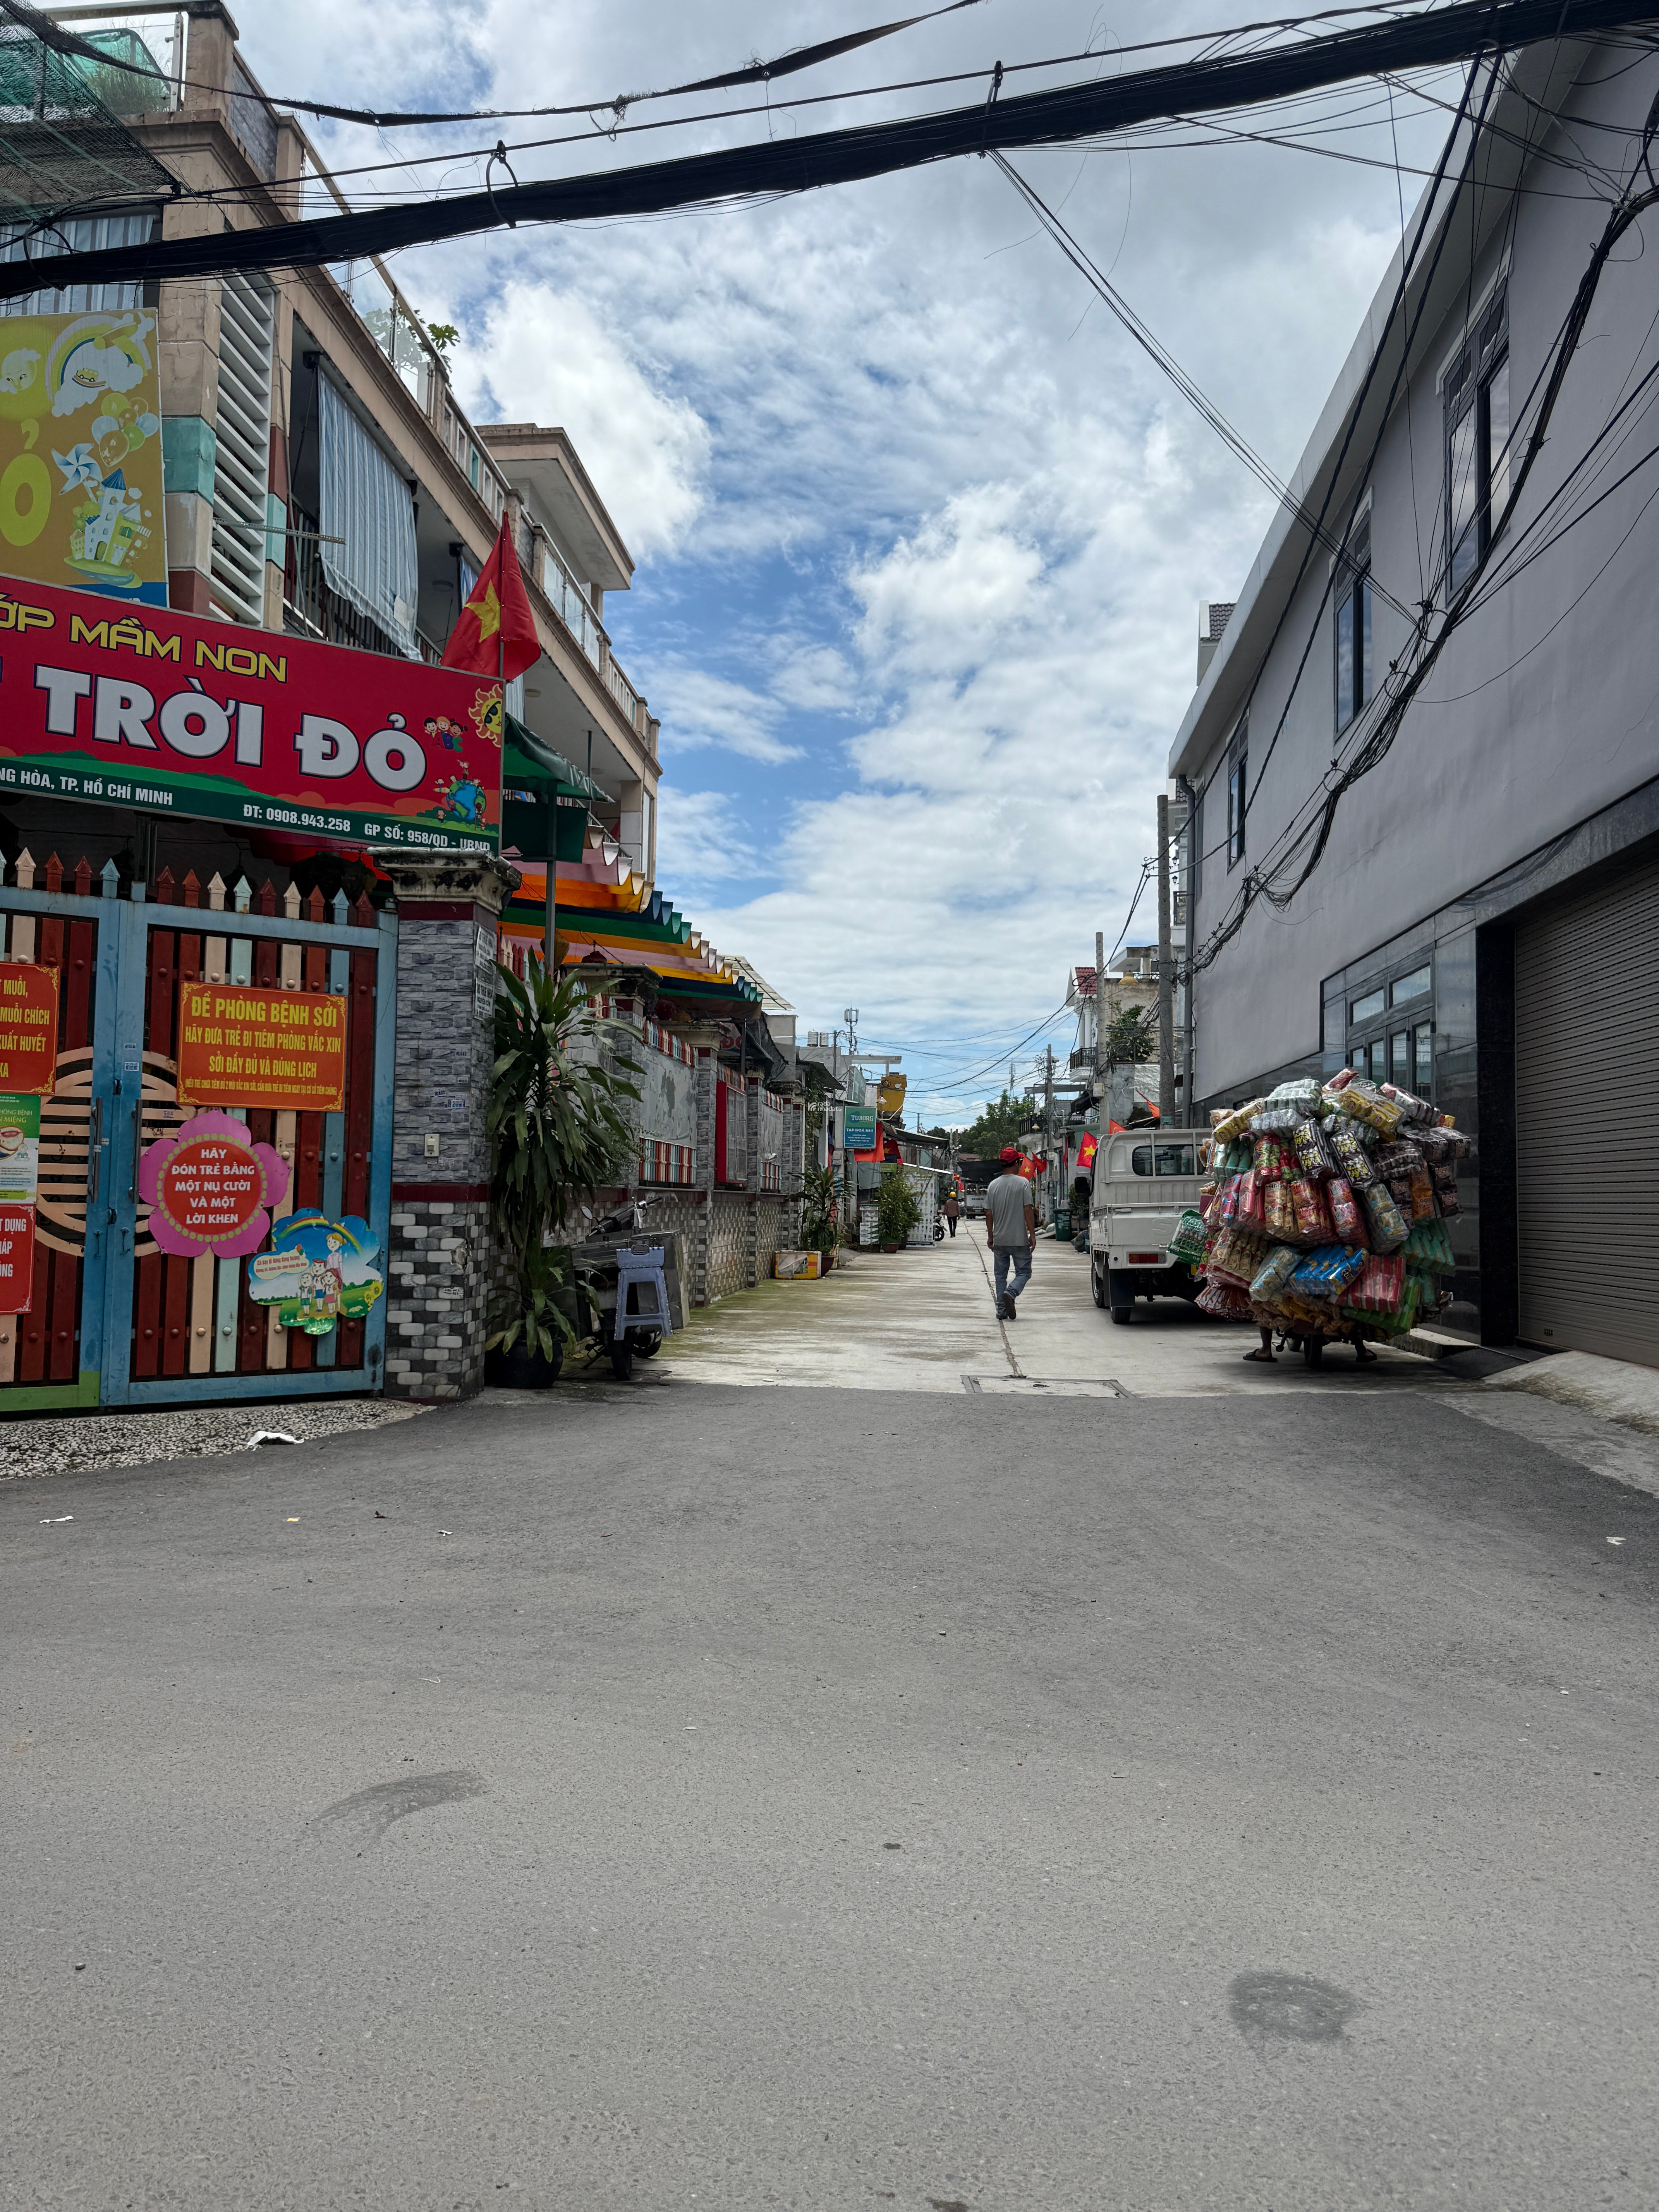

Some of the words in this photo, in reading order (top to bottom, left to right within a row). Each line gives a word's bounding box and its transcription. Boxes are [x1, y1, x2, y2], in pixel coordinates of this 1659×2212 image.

[70, 614, 181, 662] MẦM
[195, 638, 287, 684] NON
[34, 663, 264, 768] TRỜI
[293, 712, 427, 793] ĐỎ
[21, 769, 55, 790] HÒA,
[60, 776, 79, 792] TP.
[84, 778, 103, 795] HỒ
[108, 784, 131, 799] CHÍ
[136, 788, 173, 805] MINH
[243, 804, 262, 818] ĐT:
[266, 808, 350, 832] 0908.943.258
[364, 823, 380, 836] GP
[384, 824, 404, 840] SỐ:
[407, 830, 448, 847] 958/QD
[3, 975, 28, 998] MUỖI,
[0, 1003, 22, 1023] MUỖI
[24, 1006, 50, 1025] CHÍCH
[191, 991, 211, 1017] ĐỀ
[215, 995, 266, 1021] PHÒNG
[271, 1000, 309, 1028] BỆNH
[313, 1001, 337, 1027] SỞI
[20, 1032, 46, 1052] HUYẾT
[185, 1024, 203, 1043] HÃY
[204, 1027, 222, 1045] ĐƯA
[225, 1025, 240, 1046] TRẺ
[243, 1030, 252, 1047] ĐI
[254, 1029, 275, 1048] TIÊM
[277, 1030, 306, 1050] PHÒNG
[308, 1030, 324, 1052] VẮC
[326, 1037, 341, 1053] XIN
[209, 1051, 224, 1072] SỞI
[226, 1051, 244, 1073] ĐẦY
[246, 1053, 258, 1074] ĐỦ
[260, 1056, 270, 1075] VÀ
[273, 1057, 296, 1077] ĐÚNG
[298, 1061, 317, 1081] LỊCH
[201, 1147, 227, 1158] HÃY
[172, 1163, 196, 1175] ĐÓN
[200, 1163, 220, 1175] TRẺ
[223, 1162, 254, 1175] BẰNG
[175, 1180, 201, 1193] MỘT
[204, 1182, 220, 1193] NỤ
[223, 1180, 251, 1191] CƯỜI
[190, 1196, 208, 1207] VÀ
[211, 1196, 236, 1209] MỘT
[5, 1218, 26, 1234] DỤNG
[186, 1212, 205, 1224] LỜI
[208, 1214, 238, 1223] KHEN
